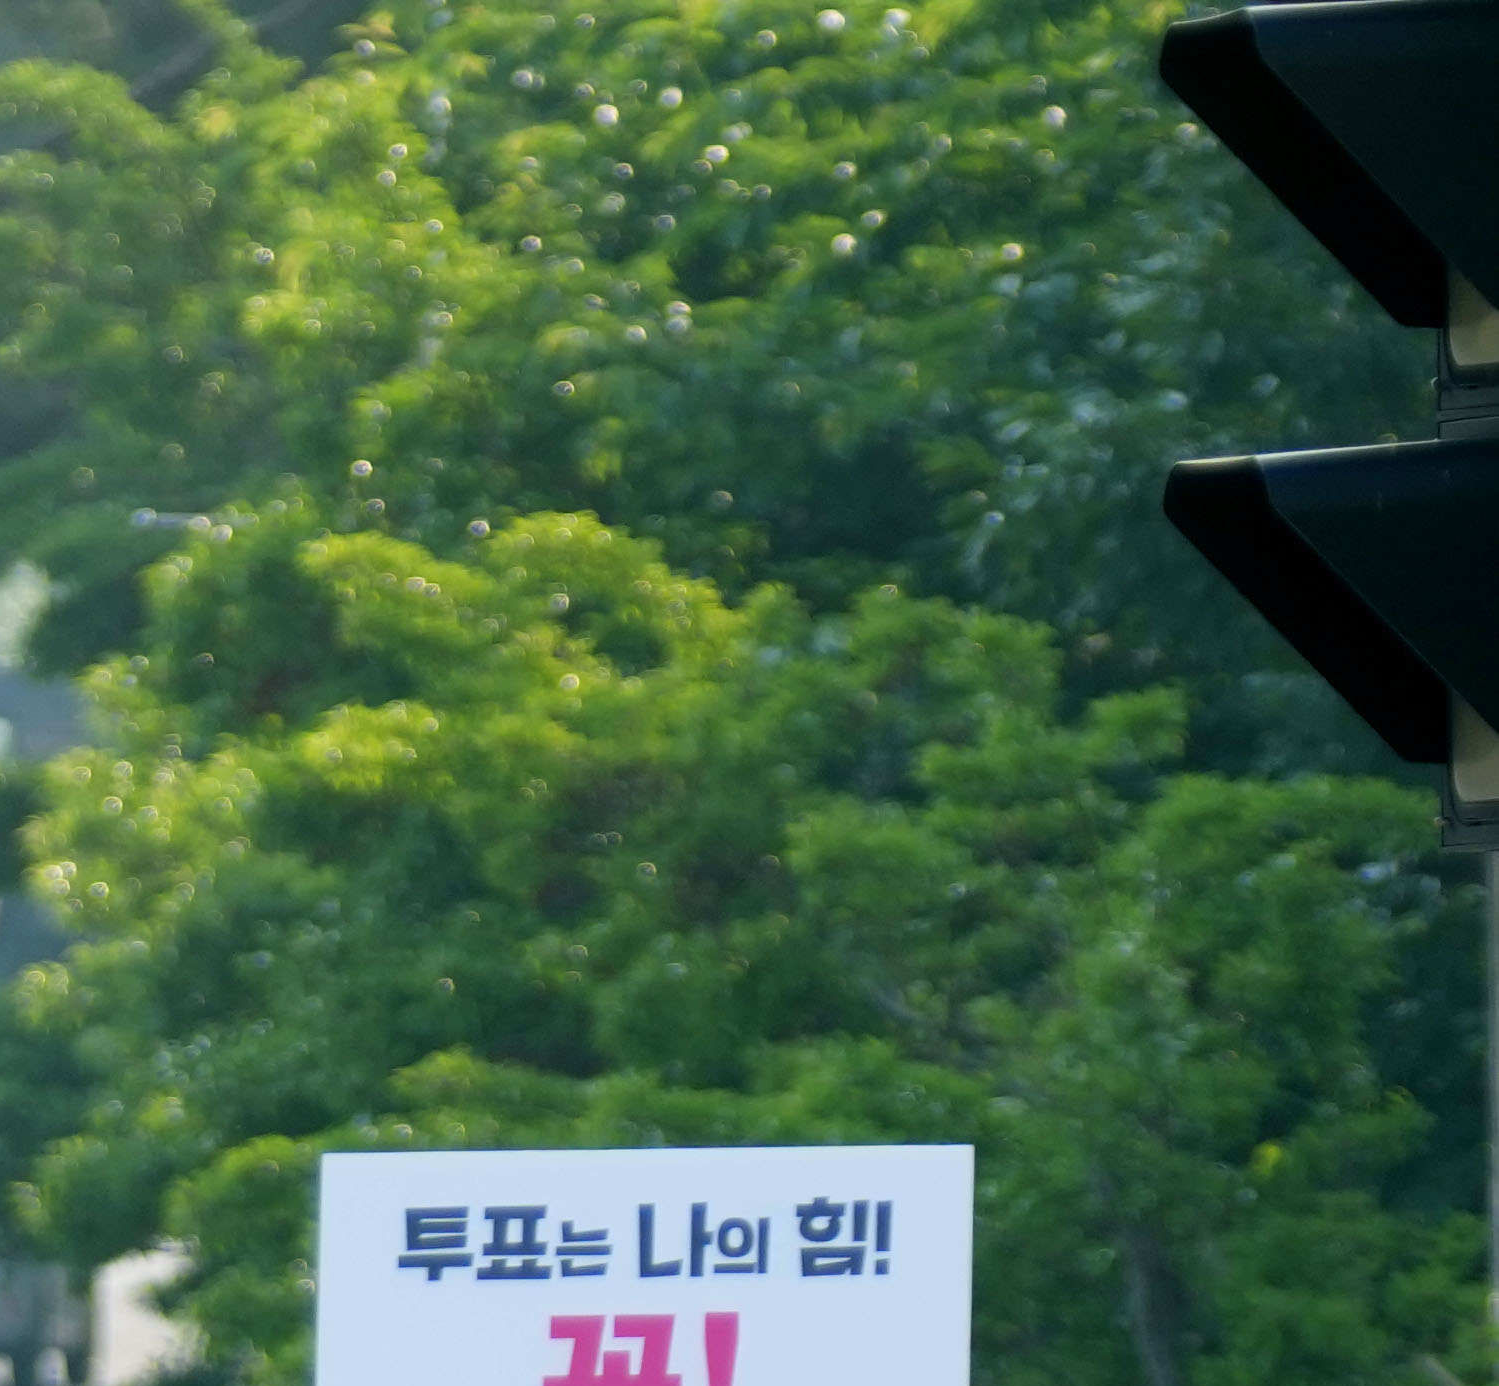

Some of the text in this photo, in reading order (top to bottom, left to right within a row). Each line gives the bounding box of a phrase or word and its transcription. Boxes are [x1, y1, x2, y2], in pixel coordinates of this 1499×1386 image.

[398, 1198, 891, 1281] 투표는 나의 힘!
